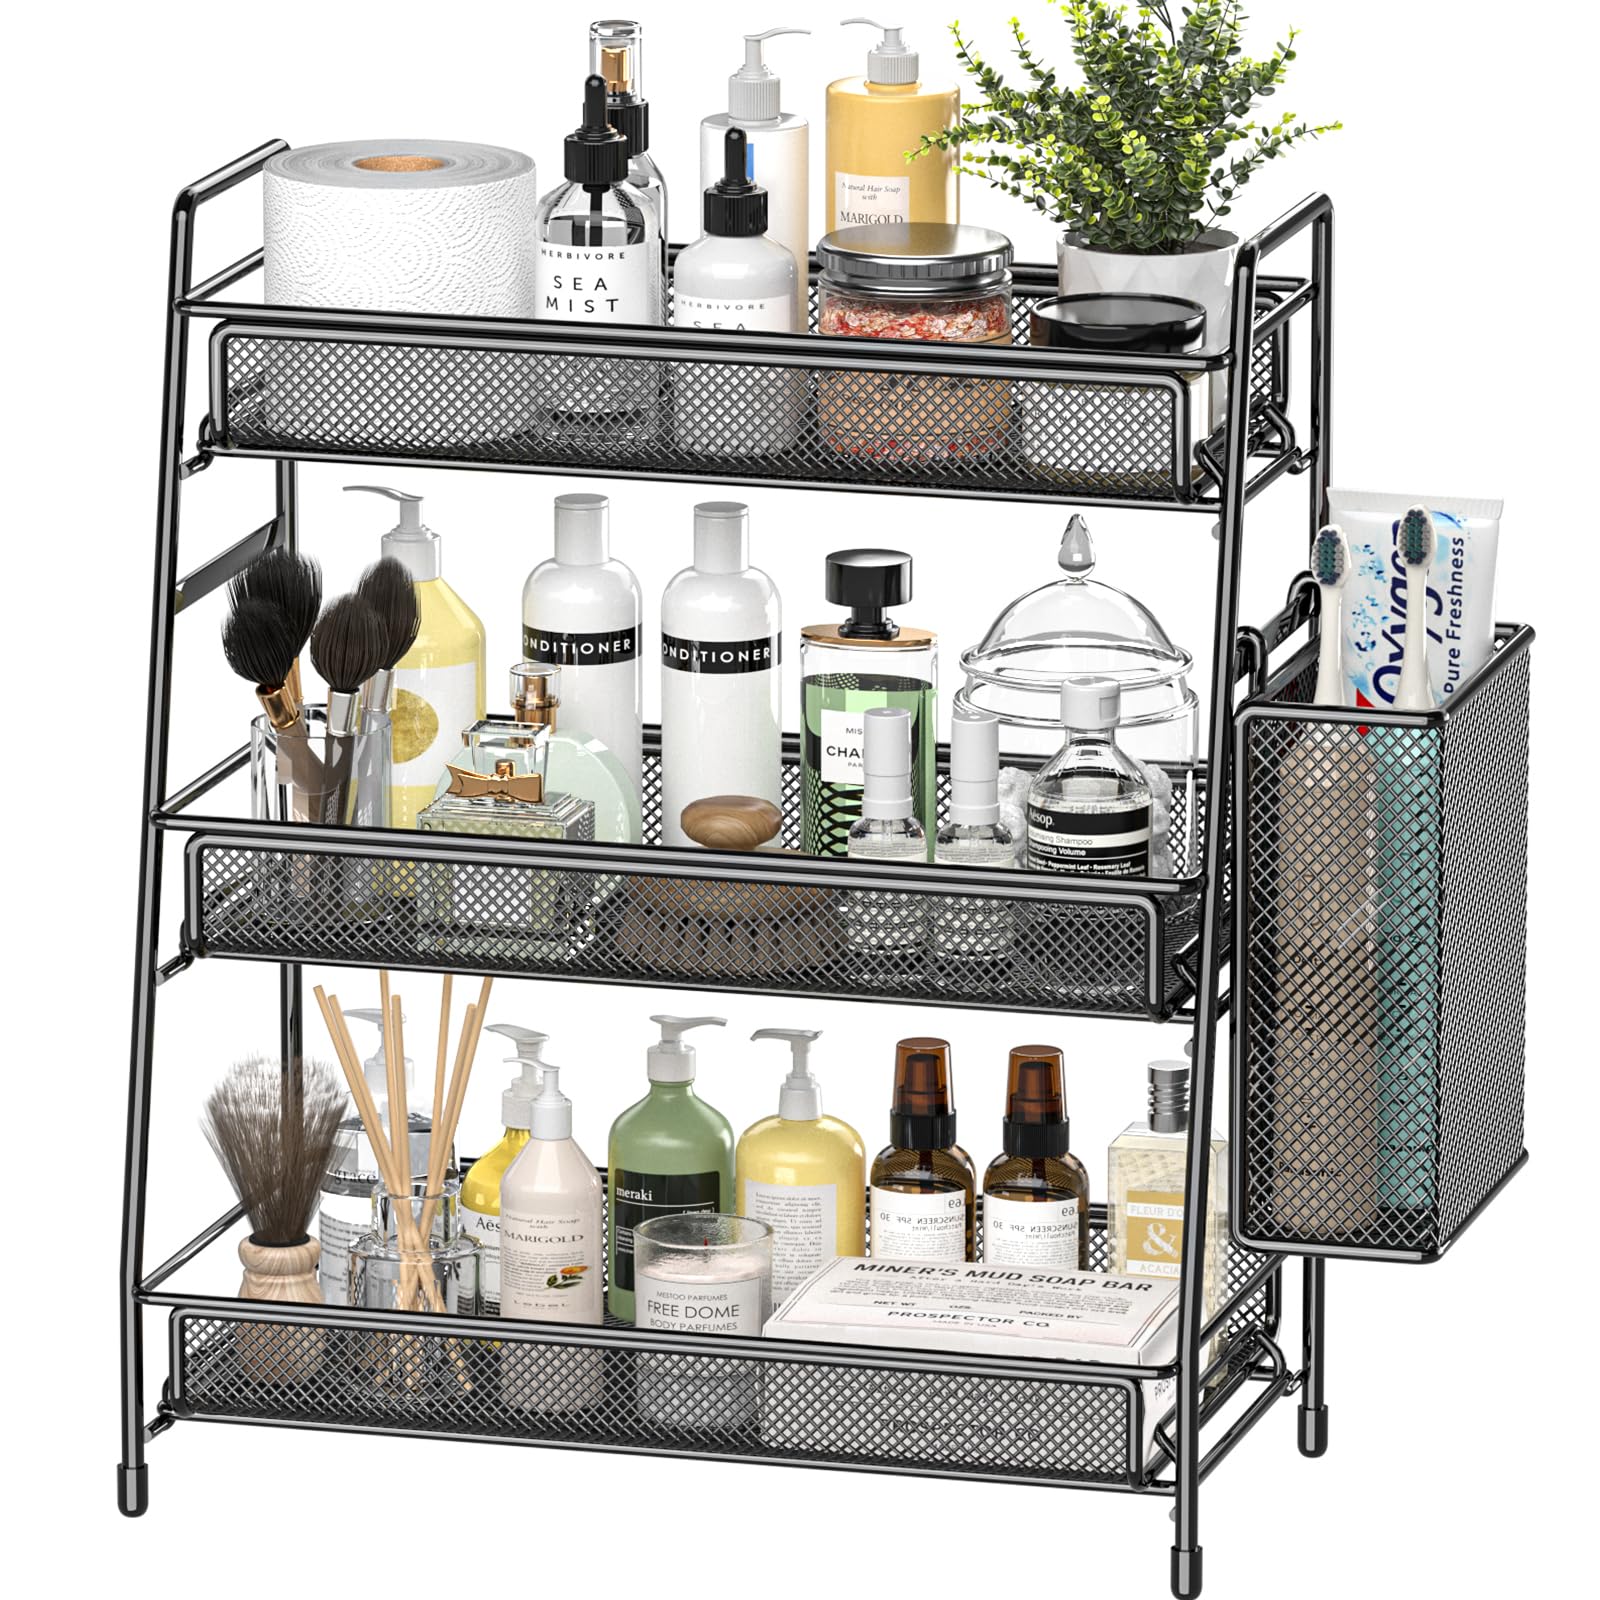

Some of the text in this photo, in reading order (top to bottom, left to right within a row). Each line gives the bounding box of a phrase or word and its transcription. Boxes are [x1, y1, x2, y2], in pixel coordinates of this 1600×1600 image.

[867, 184, 883, 192] Hair
[840, 210, 903, 224] MARIGOLD
[541, 248, 625, 260] HERBIVORE
[553, 275, 608, 291] SEA
[546, 296, 619, 313] MIST
[681, 300, 765, 311] HERBIVORE
[1443, 537, 1464, 693] Pure Freshness
[826, 745, 864, 759] CHA
[1055, 835, 1093, 846] Shampoo
[1058, 847, 1086, 857] Volume
[616, 1187, 653, 1201] meraki
[1130, 1205, 1164, 1216] FLEUR
[503, 1230, 584, 1244] MARIGOLD
[1142, 1222, 1179, 1258] &
[853, 1263, 1153, 1292] MINER'S MUD SOAP BAR
[647, 1300, 740, 1319] FREE DOME
[650, 1318, 738, 1332] BODY PARFUMES
[888, 1311, 1015, 1325] PROSPECTOR
